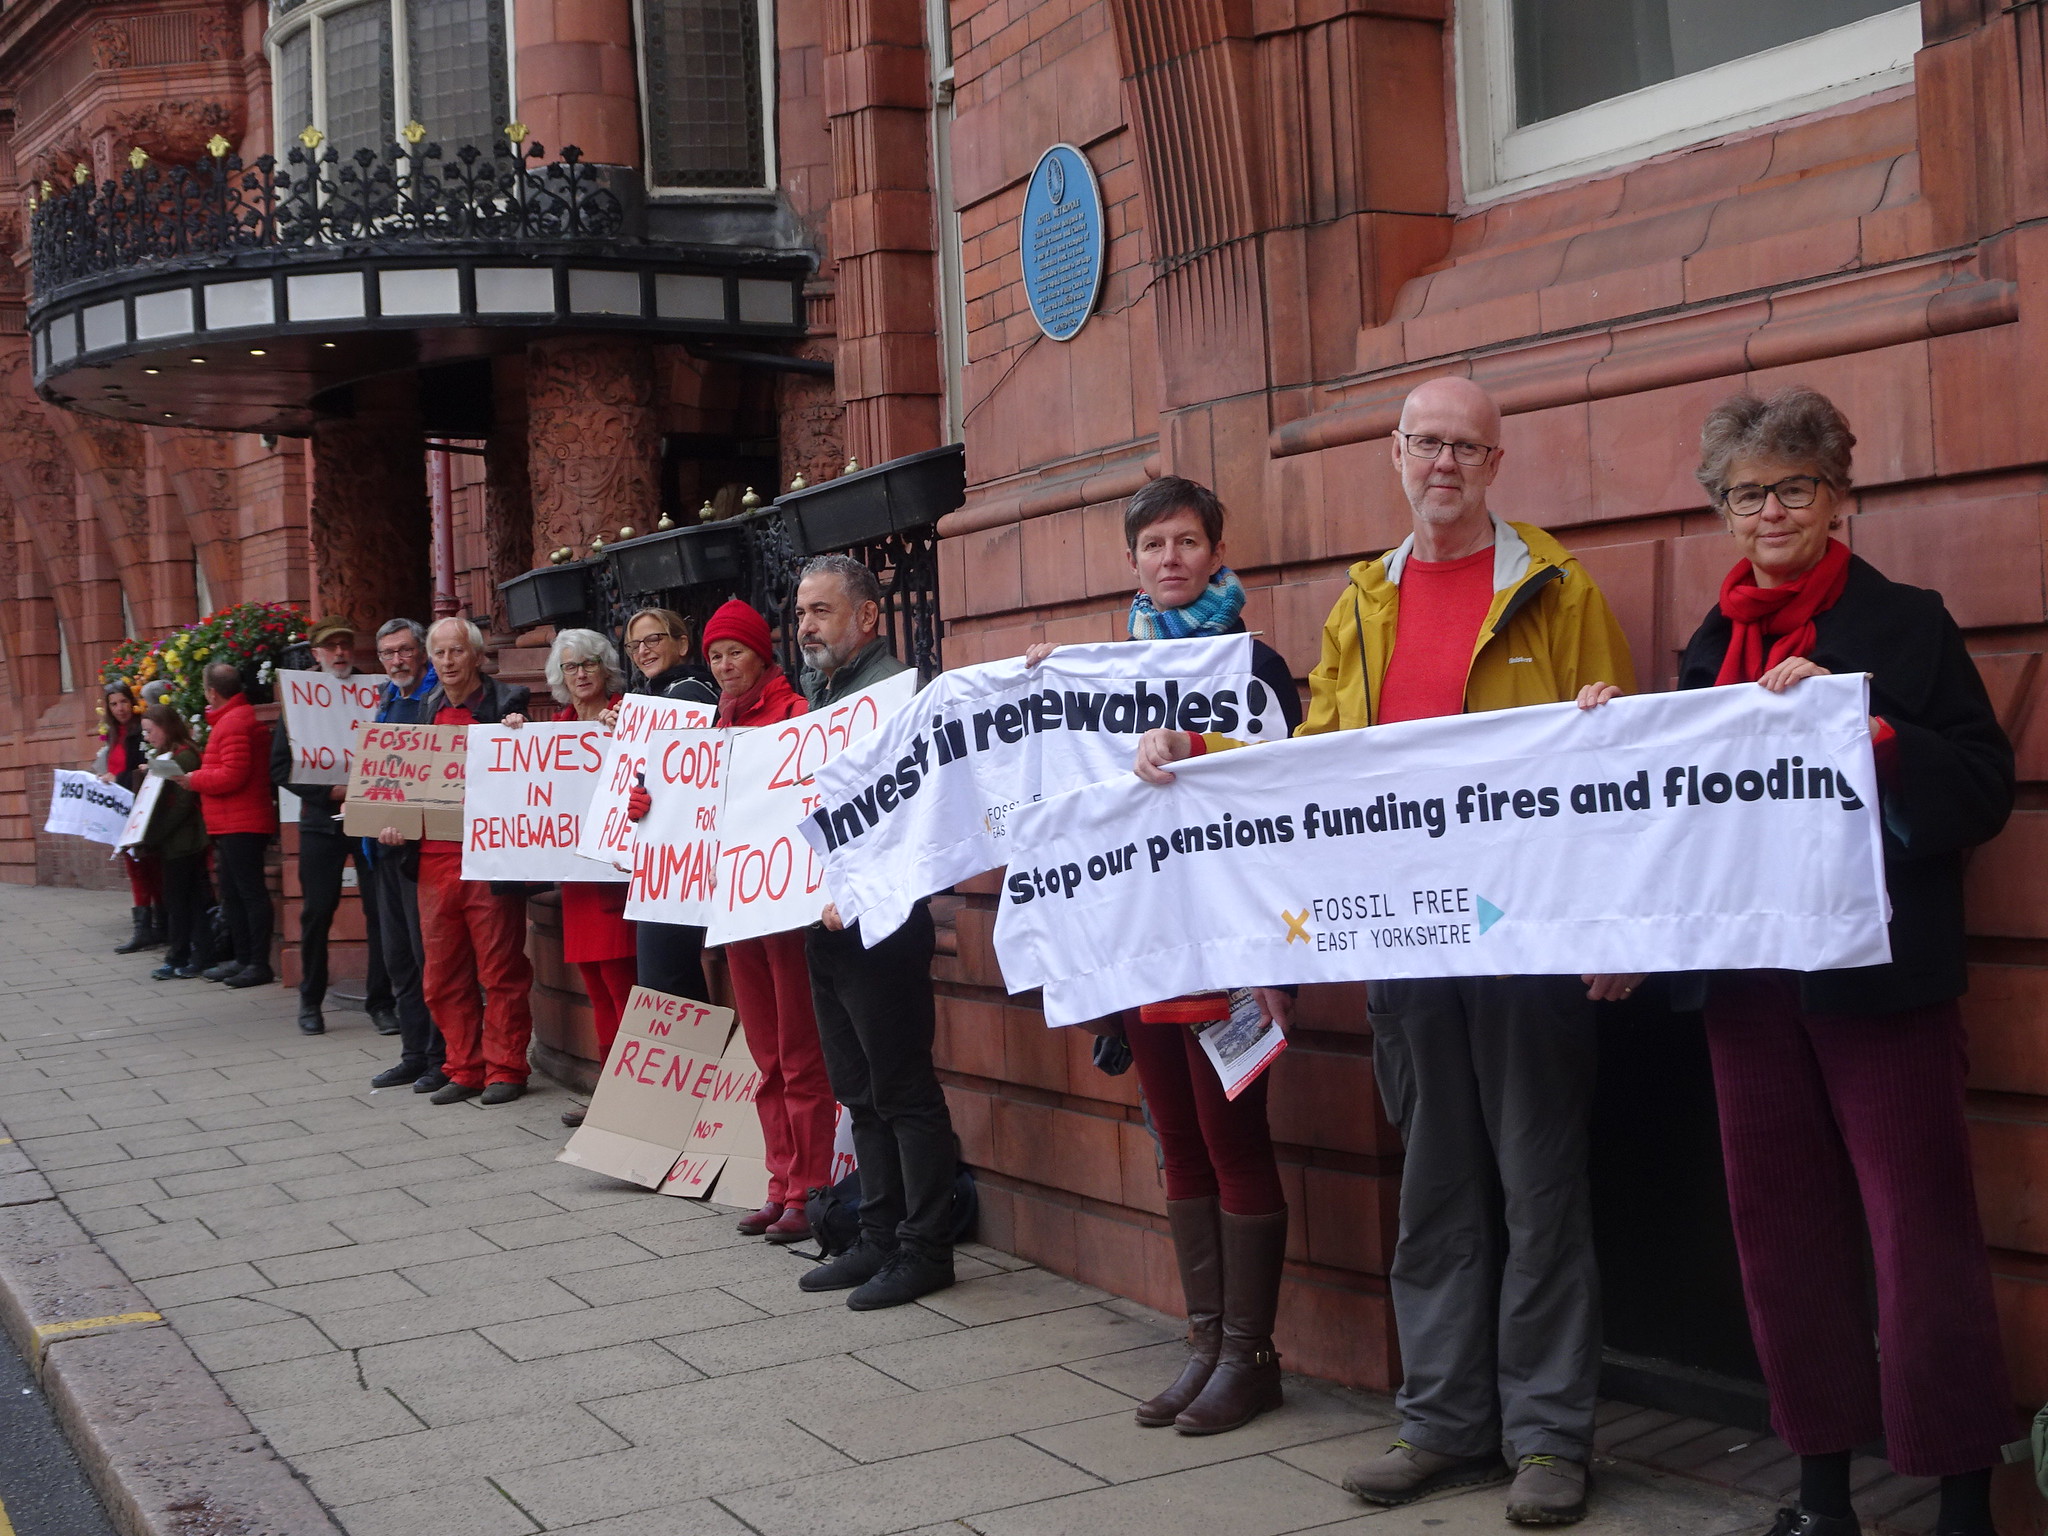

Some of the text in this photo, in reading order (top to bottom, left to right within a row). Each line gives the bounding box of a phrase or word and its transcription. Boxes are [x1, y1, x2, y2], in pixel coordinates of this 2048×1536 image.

[291, 681, 332, 708] NO
[617, 702, 650, 743] SAY
[645, 708, 677, 744] NO
[363, 728, 442, 751] FOSSIL
[768, 696, 877, 790] 2050
[302, 747, 335, 770] NO
[360, 758, 432, 782] KILLING
[663, 740, 724, 789] CODE
[813, 680, 1267, 853] Invest in renewables!
[61, 783, 83, 799] 2050
[527, 781, 552, 807] IN
[696, 805, 716, 832] FOR
[1008, 862, 1082, 905] Stop
[1087, 842, 1138, 881] our
[1147, 813, 1294, 873] pensions
[1303, 793, 1446, 839] funding
[1456, 782, 1560, 824] fires
[1570, 770, 1650, 815] and
[723, 837, 793, 912] TOO
[1312, 888, 1470, 922] FOSSIL FREE
[1316, 924, 1471, 952] EAST YORKSHIRE
[634, 992, 711, 1026] INVEST
[649, 1018, 672, 1036] IN
[693, 1120, 723, 1139] NOT
[668, 1159, 709, 1185] OIL
